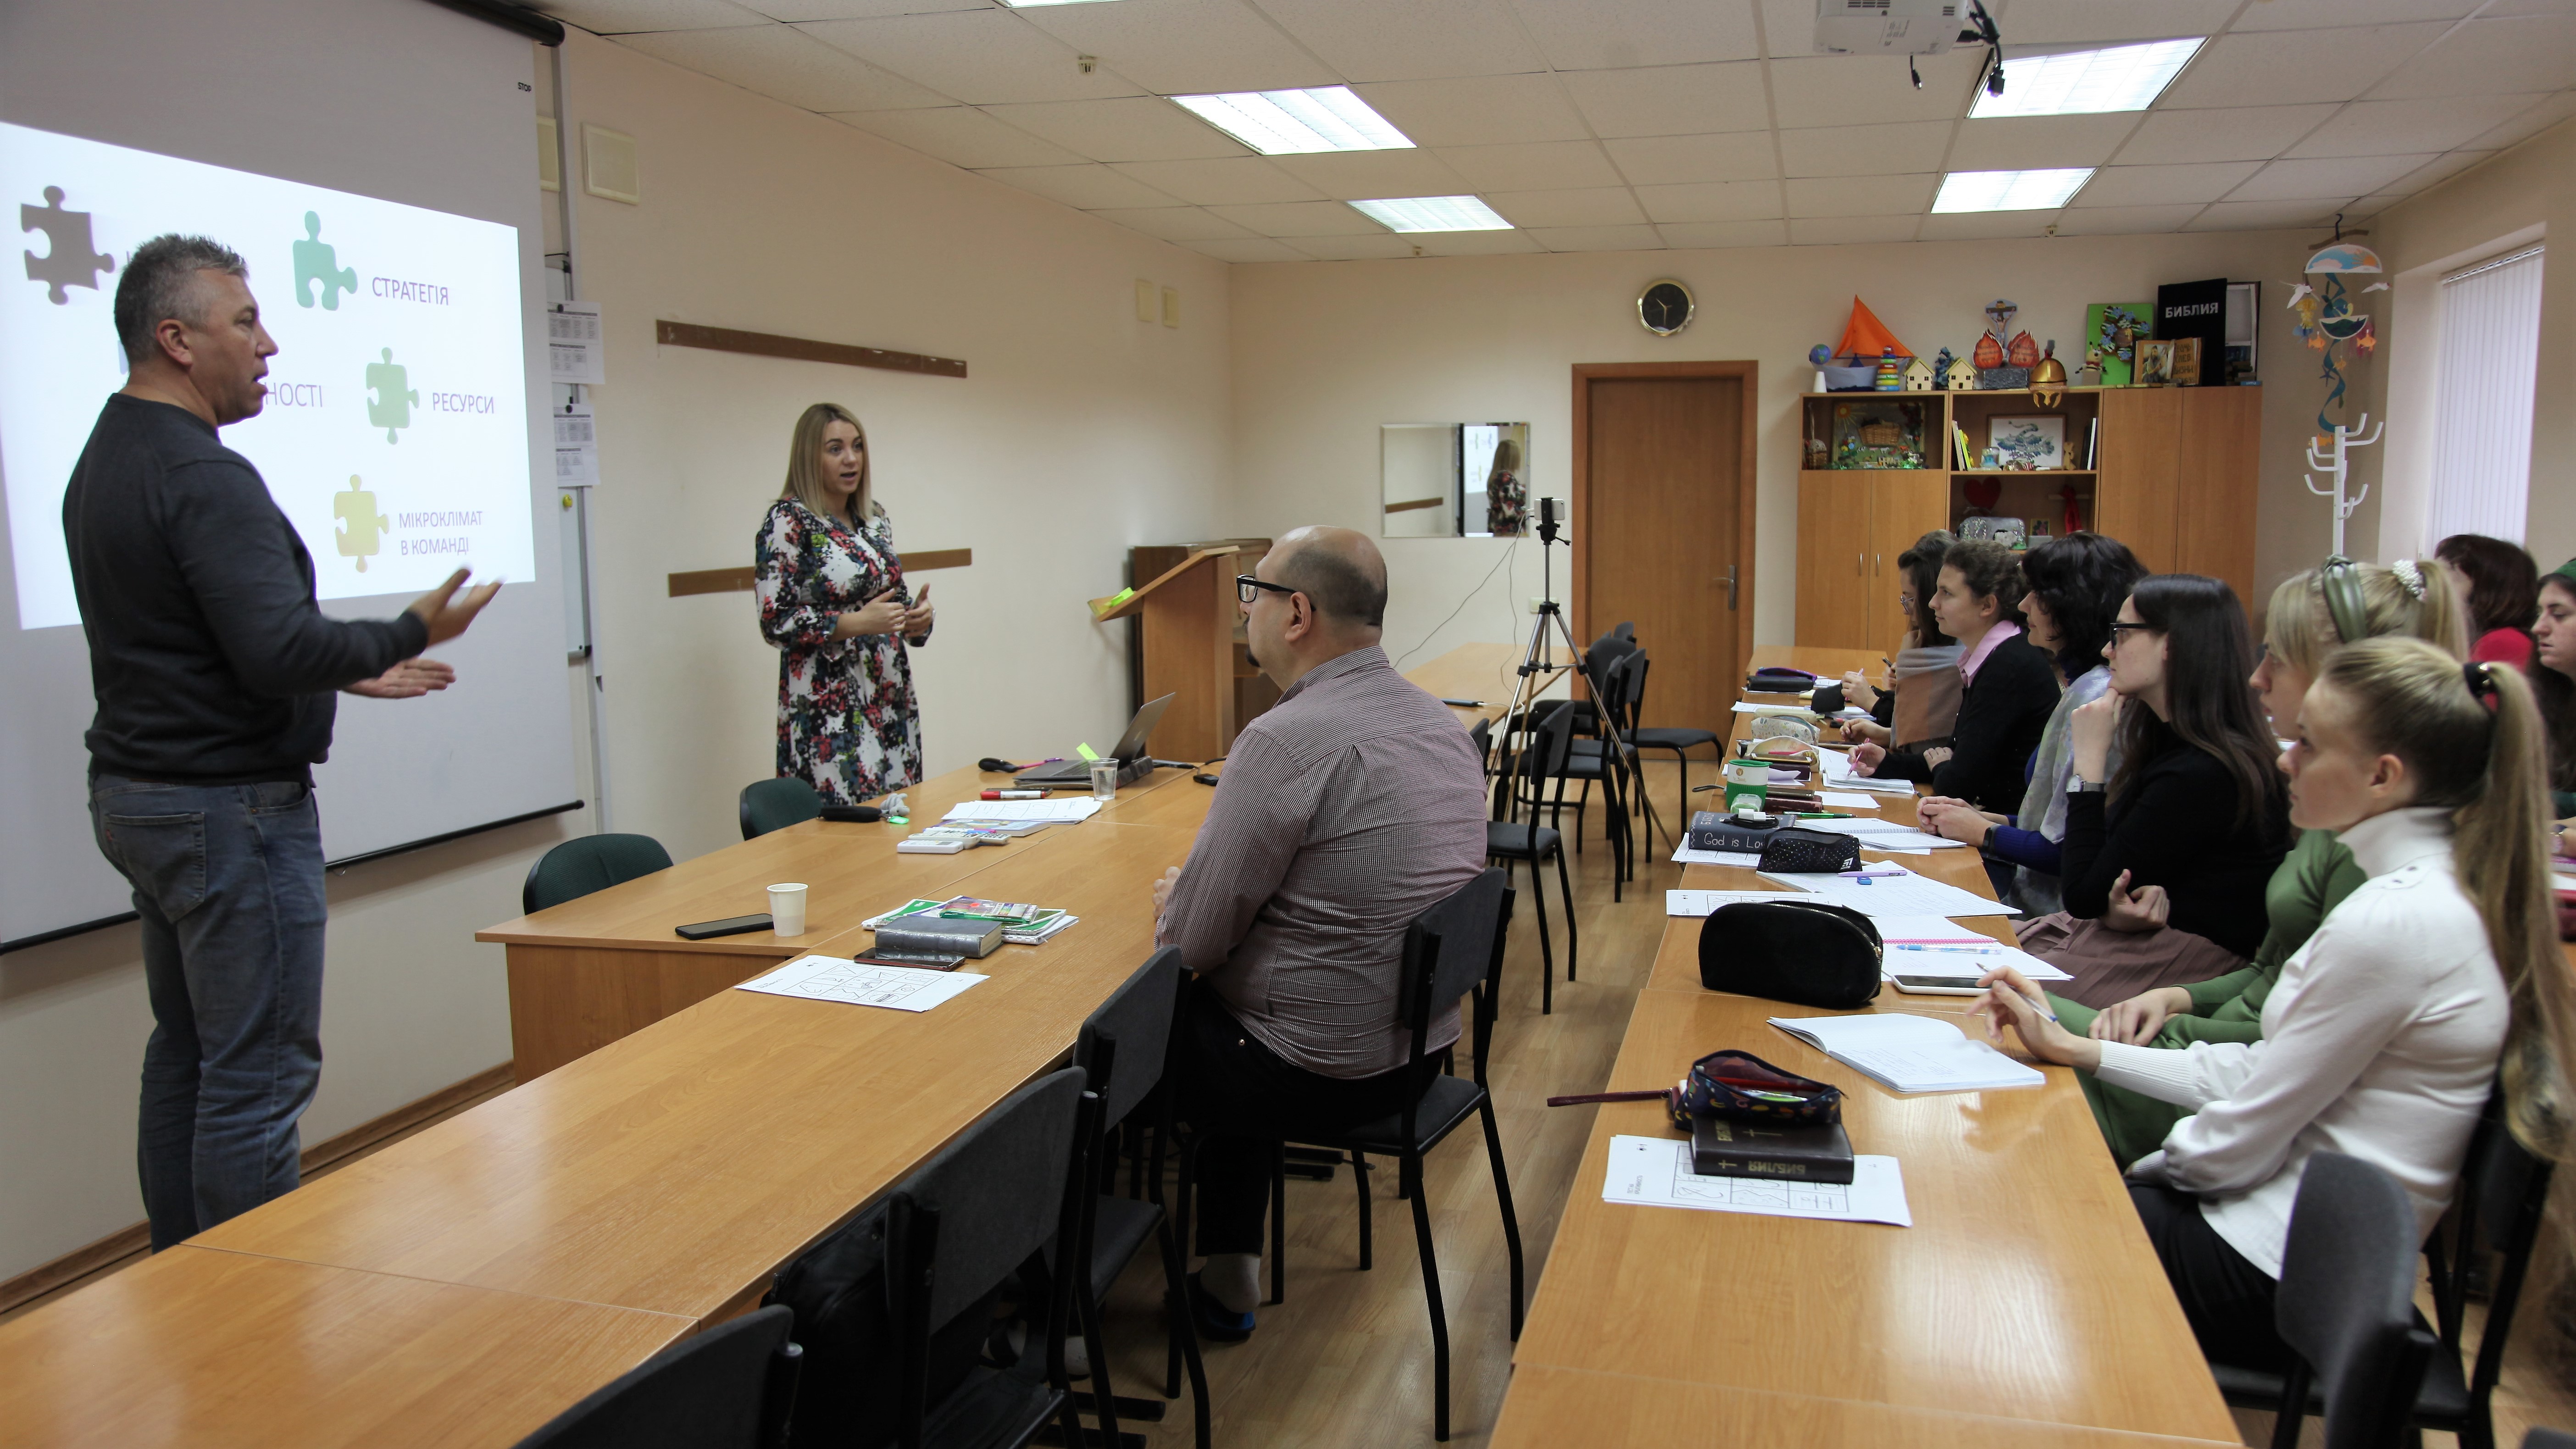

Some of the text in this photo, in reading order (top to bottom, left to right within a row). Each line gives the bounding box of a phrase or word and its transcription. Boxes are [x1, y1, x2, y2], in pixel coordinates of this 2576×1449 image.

[517, 82, 532, 93] STOP
[372, 276, 450, 306] СТРАТЕГІЯ
[2165, 302, 2219, 318] БИБЛИЯ
[264, 382, 322, 408] НОСТІ
[432, 392, 494, 414] РЕСУРСИ
[399, 511, 483, 528] МІКРОКЛІМАТ
[400, 537, 469, 556] В КОМАНДІ
[1704, 832, 1763, 849] God is Lo
[1748, 1160, 1806, 1175] БИБЛИЯ
